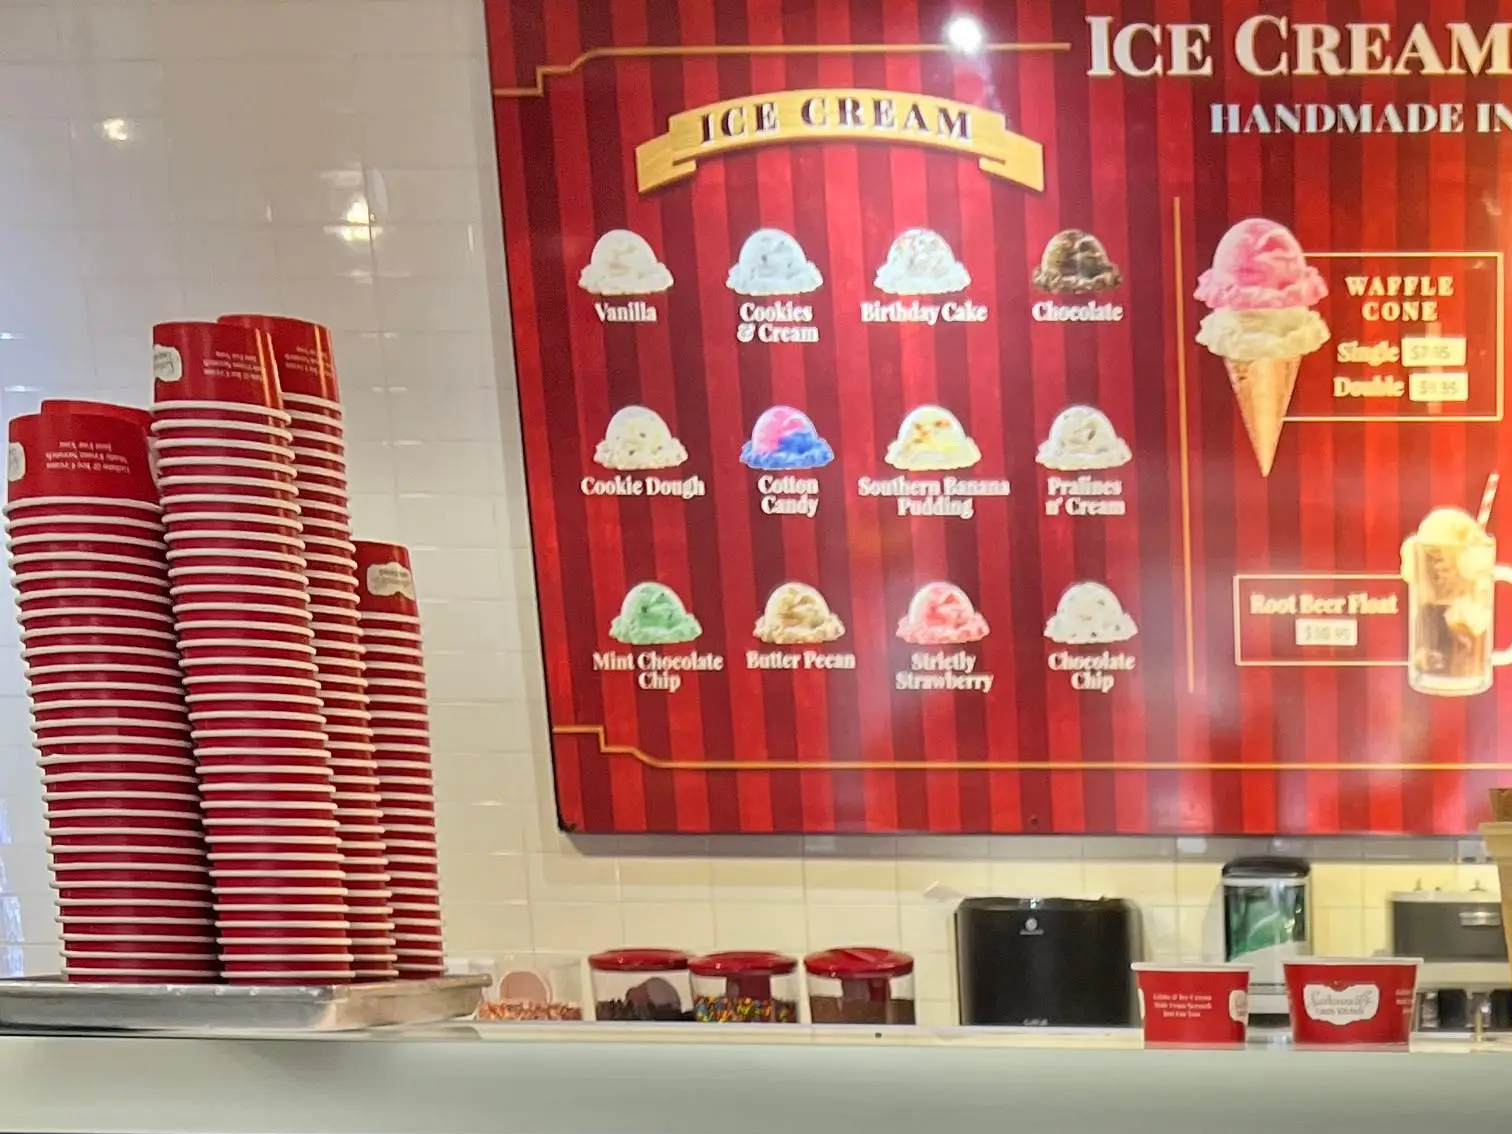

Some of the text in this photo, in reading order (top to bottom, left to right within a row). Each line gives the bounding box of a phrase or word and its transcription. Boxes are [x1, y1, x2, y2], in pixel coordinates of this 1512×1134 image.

[1086, 15, 1213, 77] ICE
[700, 96, 974, 146] ICE CREAM
[1210, 102, 1464, 134] HANDMADE
[1345, 276, 1454, 297] WAFFLE
[594, 302, 657, 323] Vanilla
[739, 302, 813, 323] Cookies
[860, 302, 987, 326] Birthday Cake
[1031, 302, 1122, 323] Chocolate
[1362, 301, 1438, 322] CONE
[736, 322, 819, 344] & Cream
[581, 476, 705, 499] Cookie Dough
[758, 475, 819, 496] Cotton
[858, 477, 1010, 496] Southern Banana
[1047, 476, 1122, 496] Pralines
[760, 497, 819, 518] Candy
[897, 497, 974, 519] Pudding
[1065, 497, 1126, 516] Cream
[1250, 592, 1297, 615] Root
[1299, 592, 1346, 615] Beer
[593, 651, 724, 671] Mint Chocolate
[746, 651, 856, 670] Butter Pecan
[911, 651, 976, 674] Strictly
[1047, 652, 1135, 671] Chocolate
[638, 671, 681, 693] Chip
[895, 671, 993, 693] Strawberry
[1071, 671, 1114, 693] Chip
